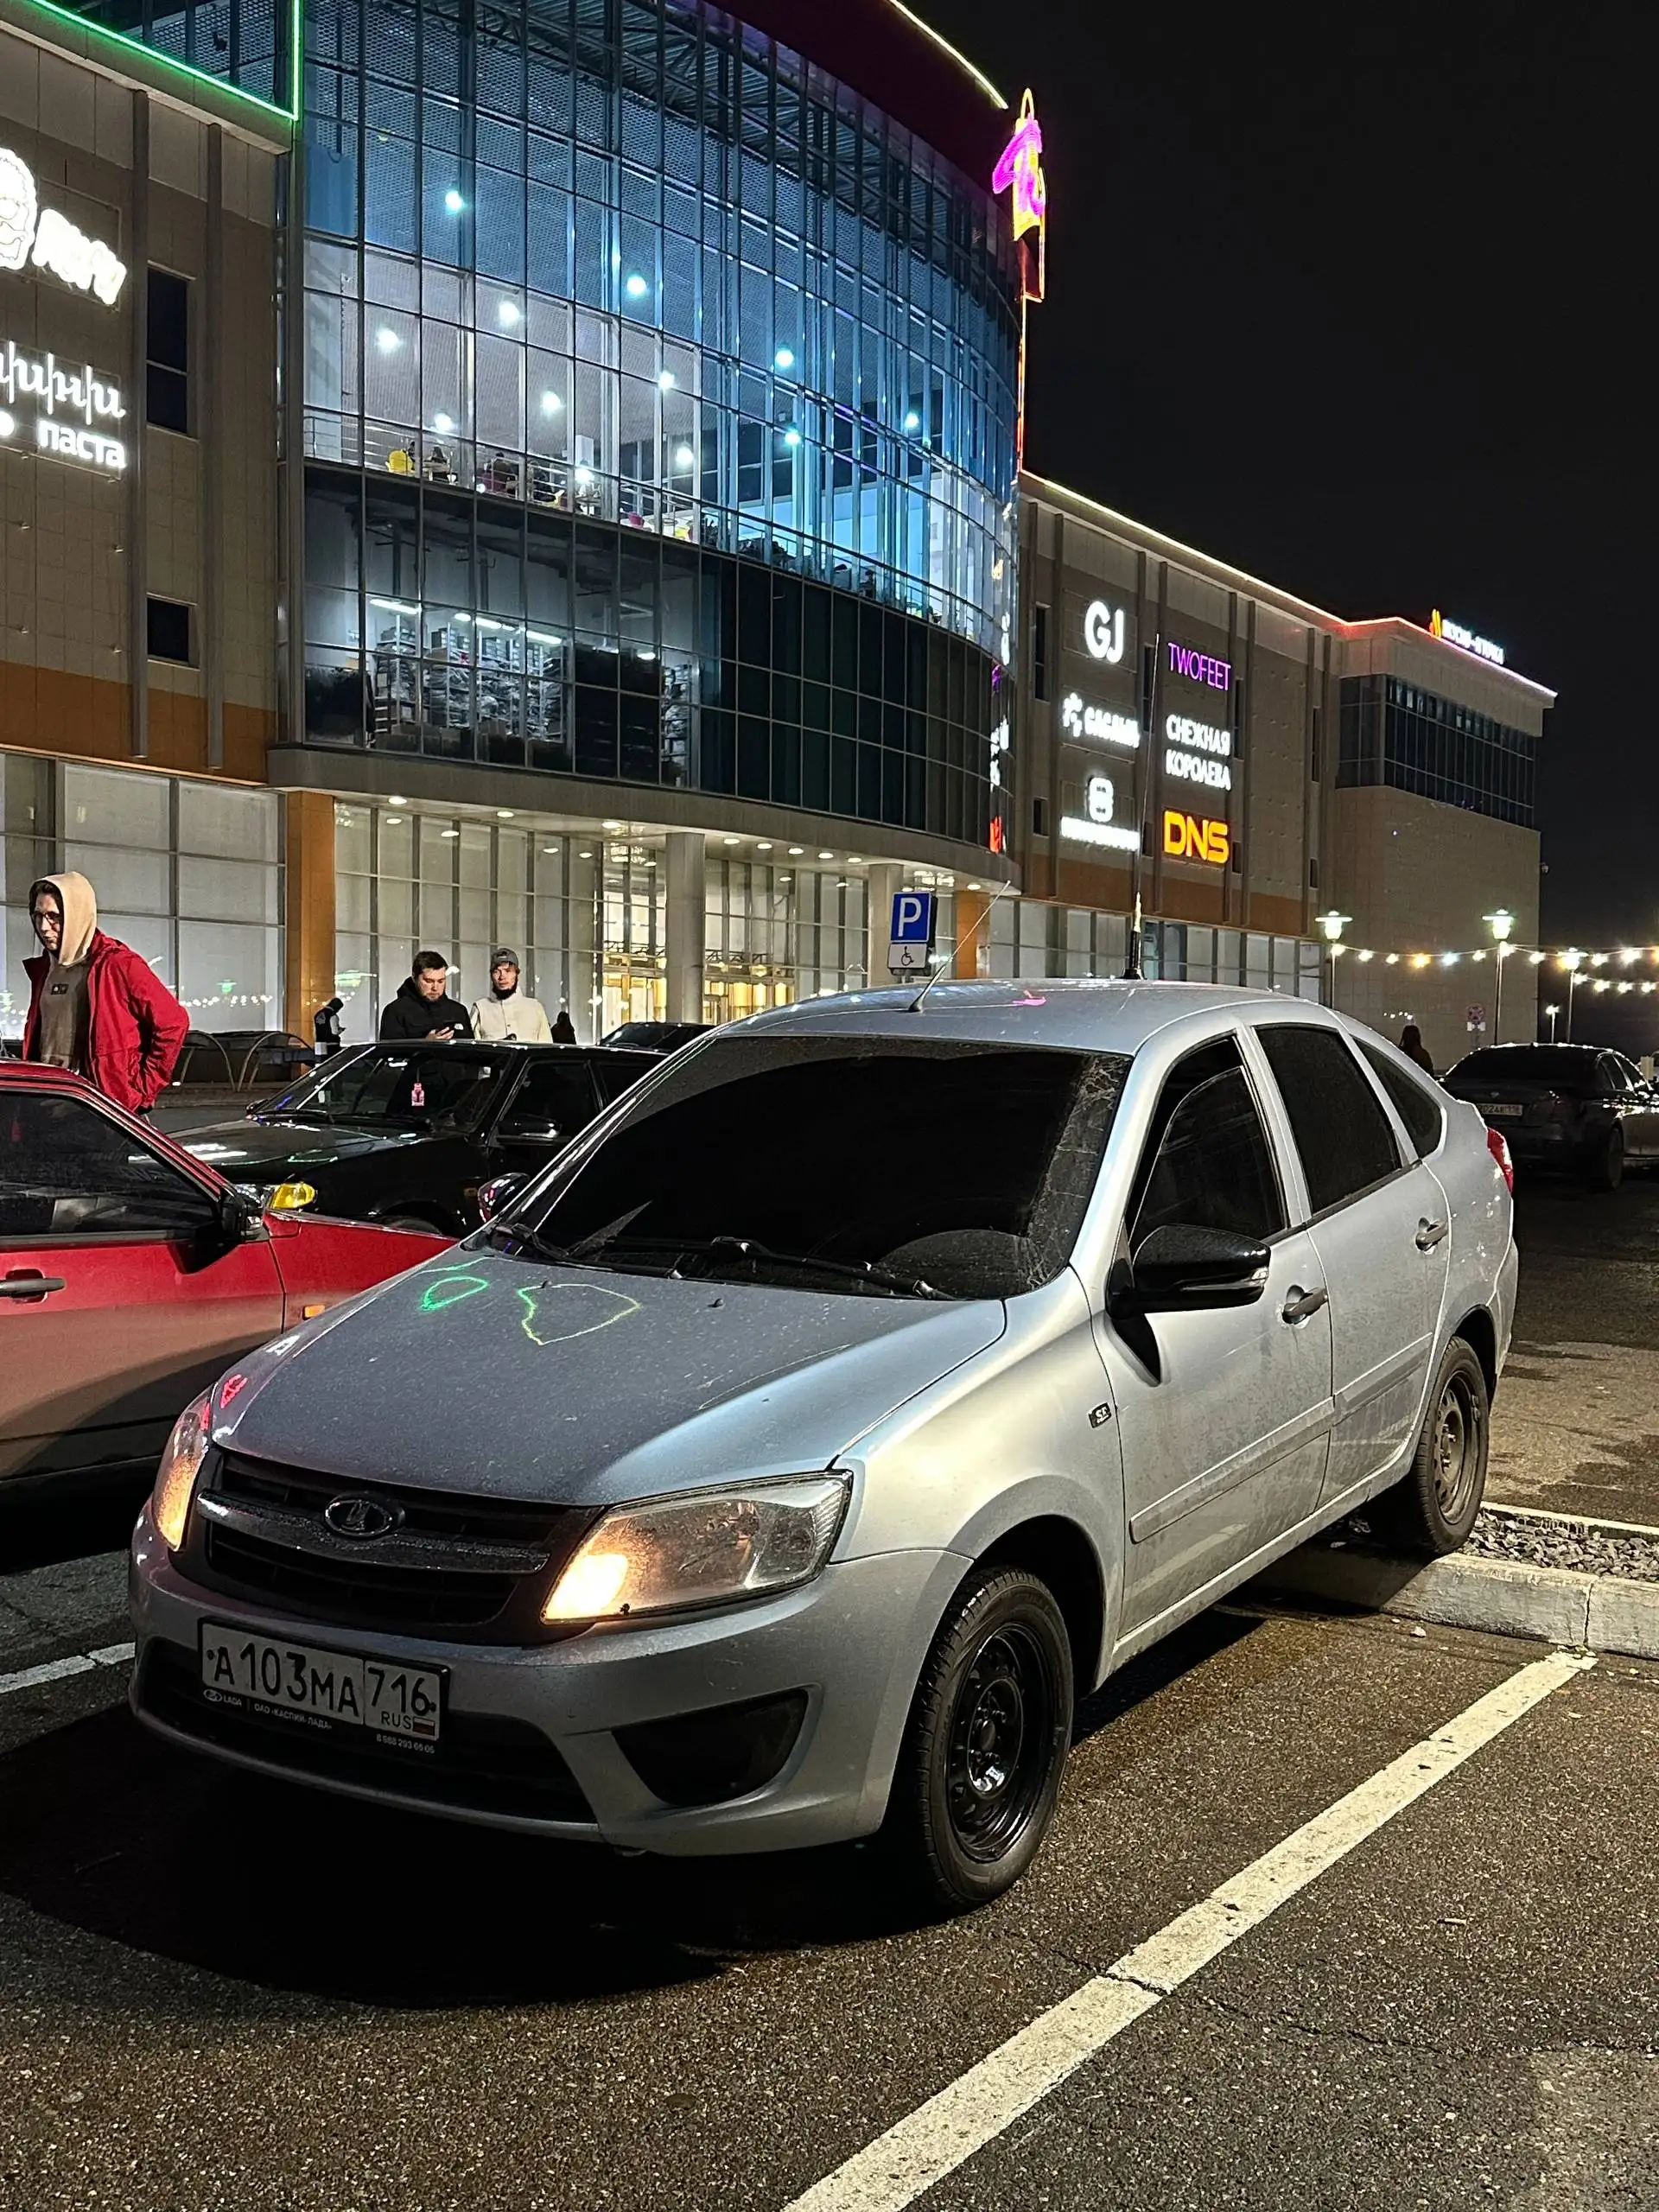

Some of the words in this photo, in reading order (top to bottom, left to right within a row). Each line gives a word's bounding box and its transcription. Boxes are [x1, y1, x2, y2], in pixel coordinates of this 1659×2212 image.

[37, 419, 127, 469] паста
[1084, 601, 1127, 664] GJ
[1167, 642, 1231, 691] TWOFEET
[1166, 714, 1231, 756] СНЕЖНАЯ
[1166, 749, 1232, 791] КОРОЛЕВА
[1163, 810, 1230, 864] DNS
[898, 897, 922, 938] P
[367, 1667, 437, 1717] 716
[380, 1710, 413, 1731] RUS
